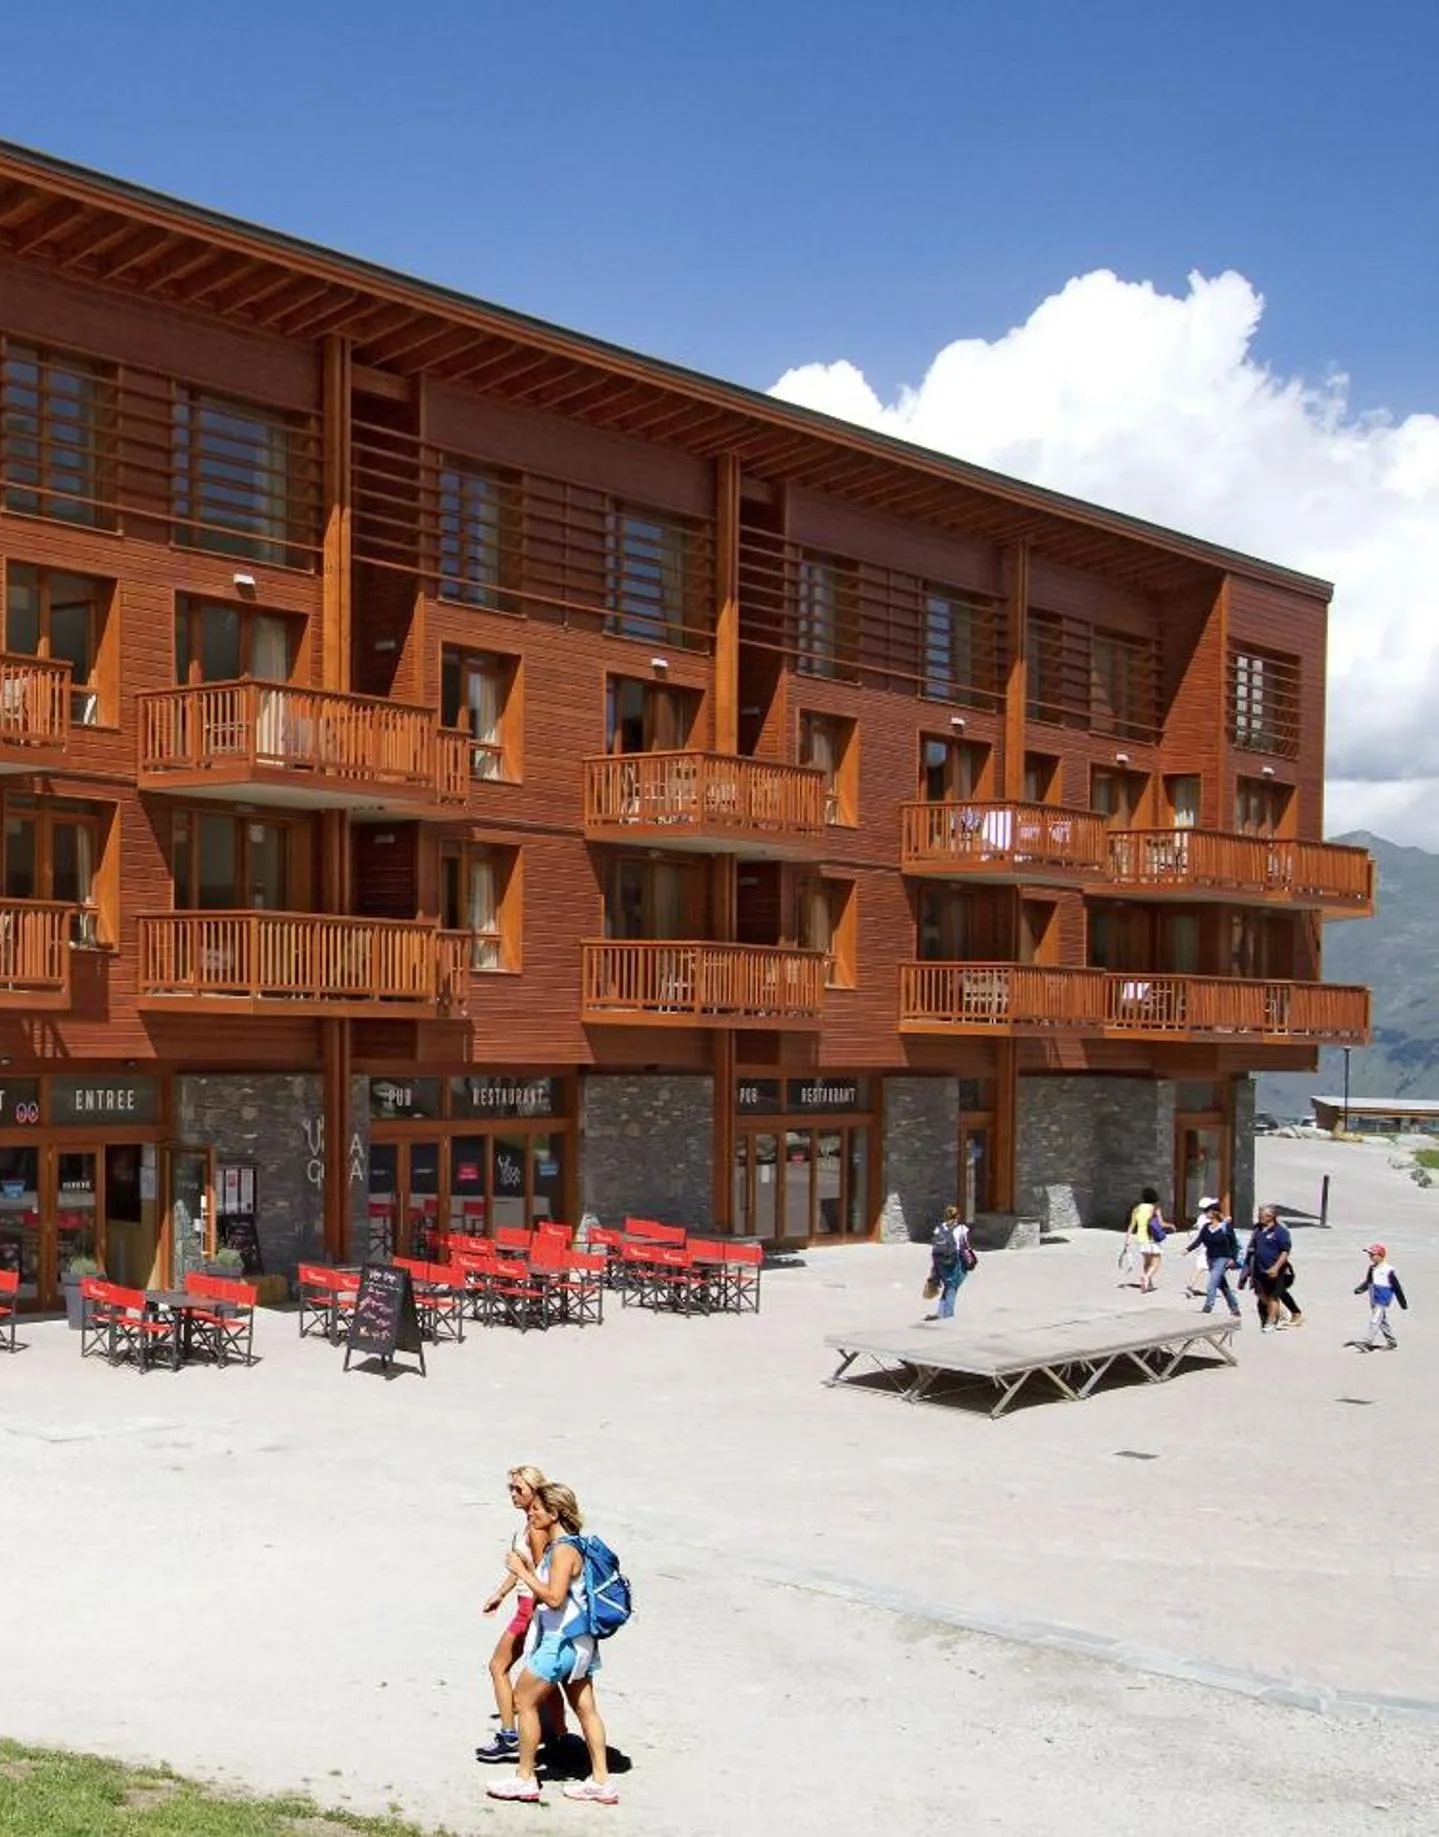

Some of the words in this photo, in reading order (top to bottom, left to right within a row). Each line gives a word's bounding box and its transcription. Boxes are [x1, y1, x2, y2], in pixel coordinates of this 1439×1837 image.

[74, 1089, 136, 1111] ENTREE
[388, 1087, 412, 1106] PUB
[472, 1087, 547, 1107] RESTAURANT
[740, 1087, 758, 1104] PUB
[801, 1087, 856, 1103] RESTAURANT
